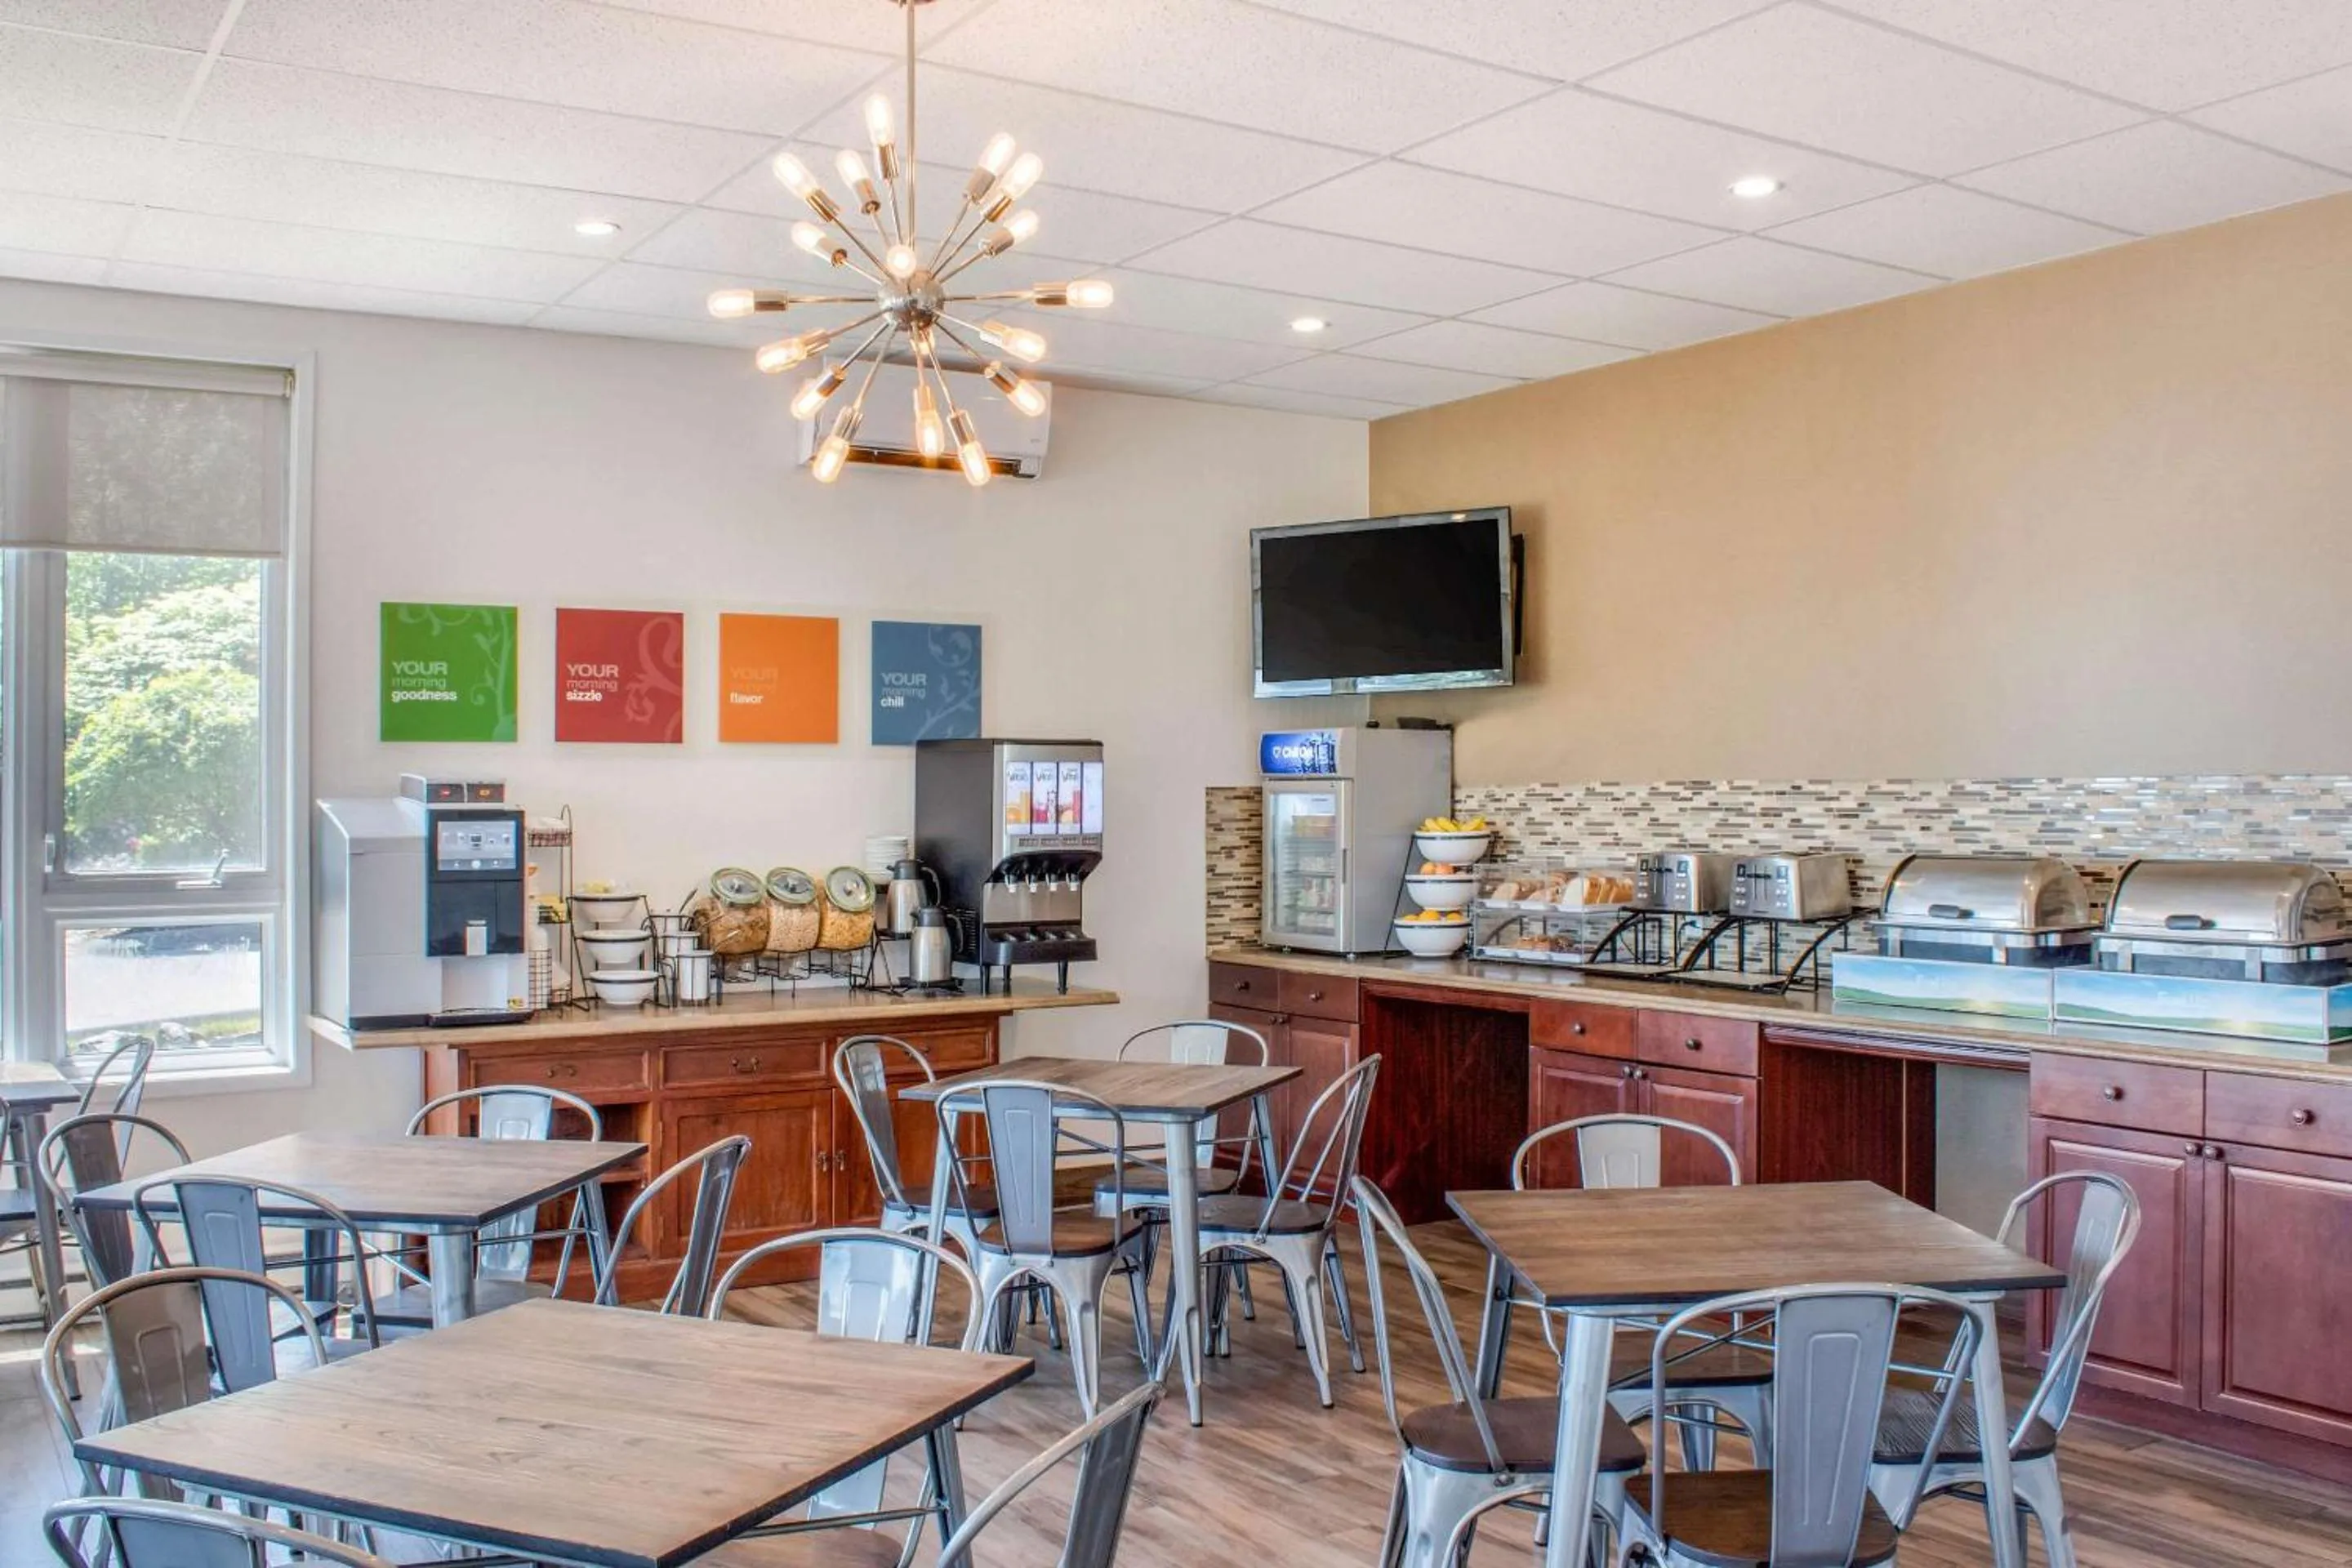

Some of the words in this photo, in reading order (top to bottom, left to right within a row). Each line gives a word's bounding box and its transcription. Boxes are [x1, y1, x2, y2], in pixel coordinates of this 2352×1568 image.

[392, 660, 448, 676] YOUR
[566, 662, 619, 678] YOUR
[566, 679, 618, 693] morning
[880, 672, 927, 687] YOUR
[391, 689, 458, 703] goodness
[566, 689, 603, 702] sizzle
[729, 691, 764, 704] flavor
[880, 695, 904, 708] chill
